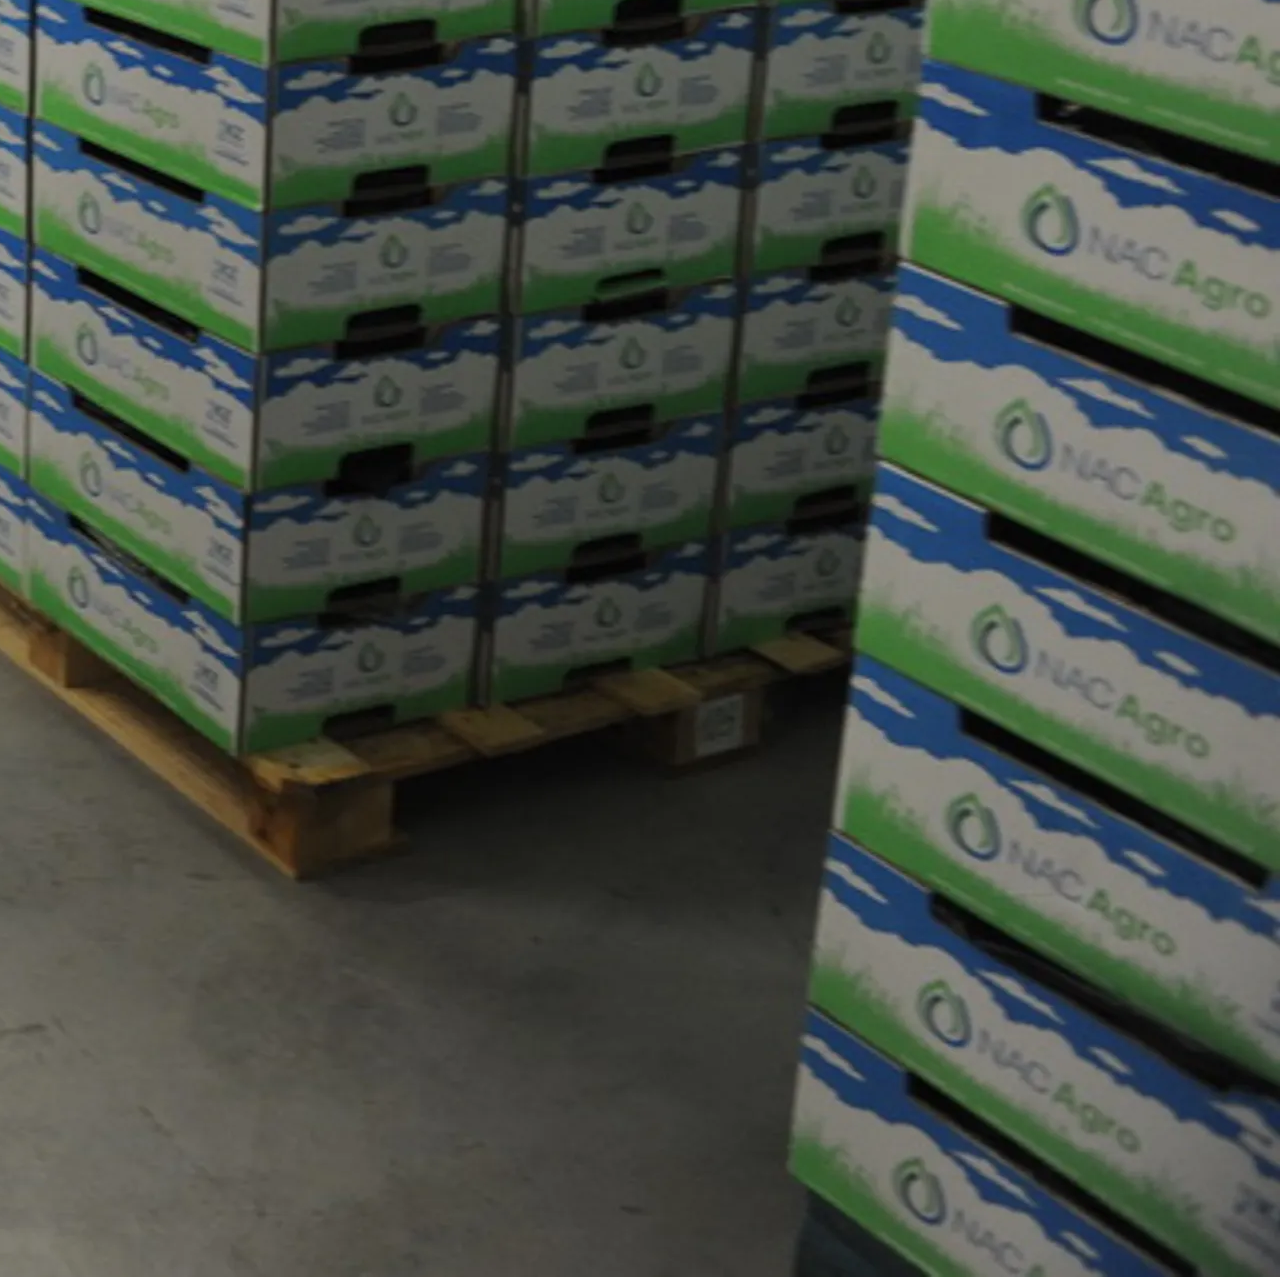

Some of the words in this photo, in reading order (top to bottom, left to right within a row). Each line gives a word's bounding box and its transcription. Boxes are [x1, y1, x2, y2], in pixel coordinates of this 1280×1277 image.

[1086, 225, 1273, 320] NACAgro
[1060, 441, 1236, 545] NACAgro
[1034, 649, 1212, 760] NACAgro
[1007, 838, 1178, 957] NACAgro
[975, 1027, 1141, 1154] NACAgro
